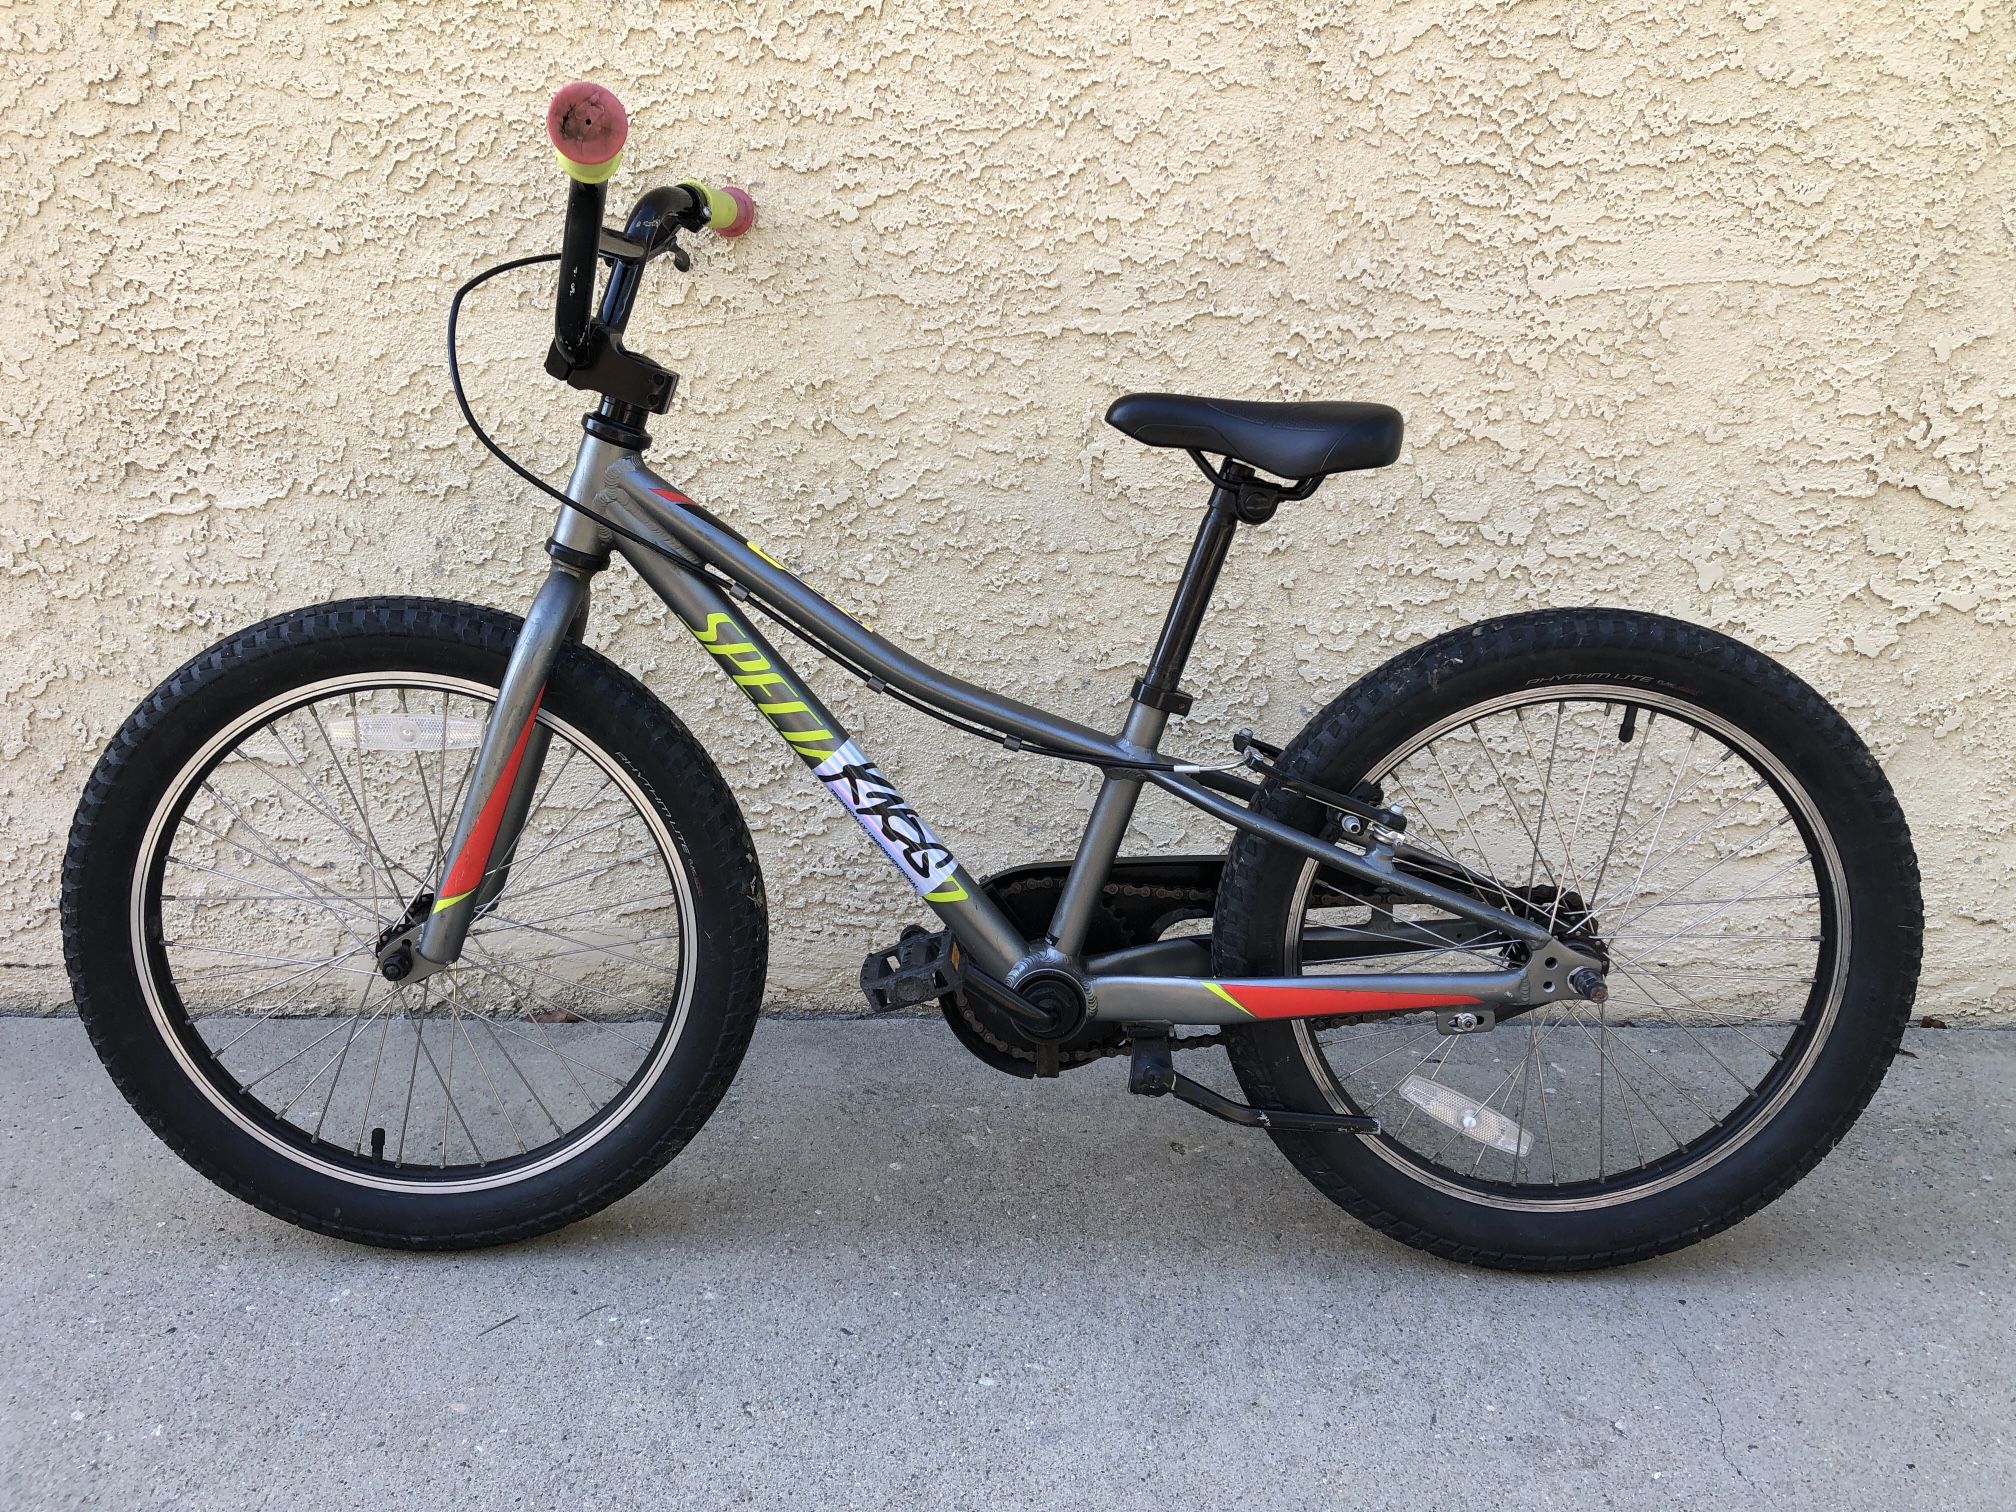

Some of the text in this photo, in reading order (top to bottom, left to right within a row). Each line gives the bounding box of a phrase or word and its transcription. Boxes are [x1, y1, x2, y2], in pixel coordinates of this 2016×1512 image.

[1613, 673, 1654, 682] LITE
[830, 788, 868, 830] TECHNICALLY
[669, 820, 690, 854] LITE
